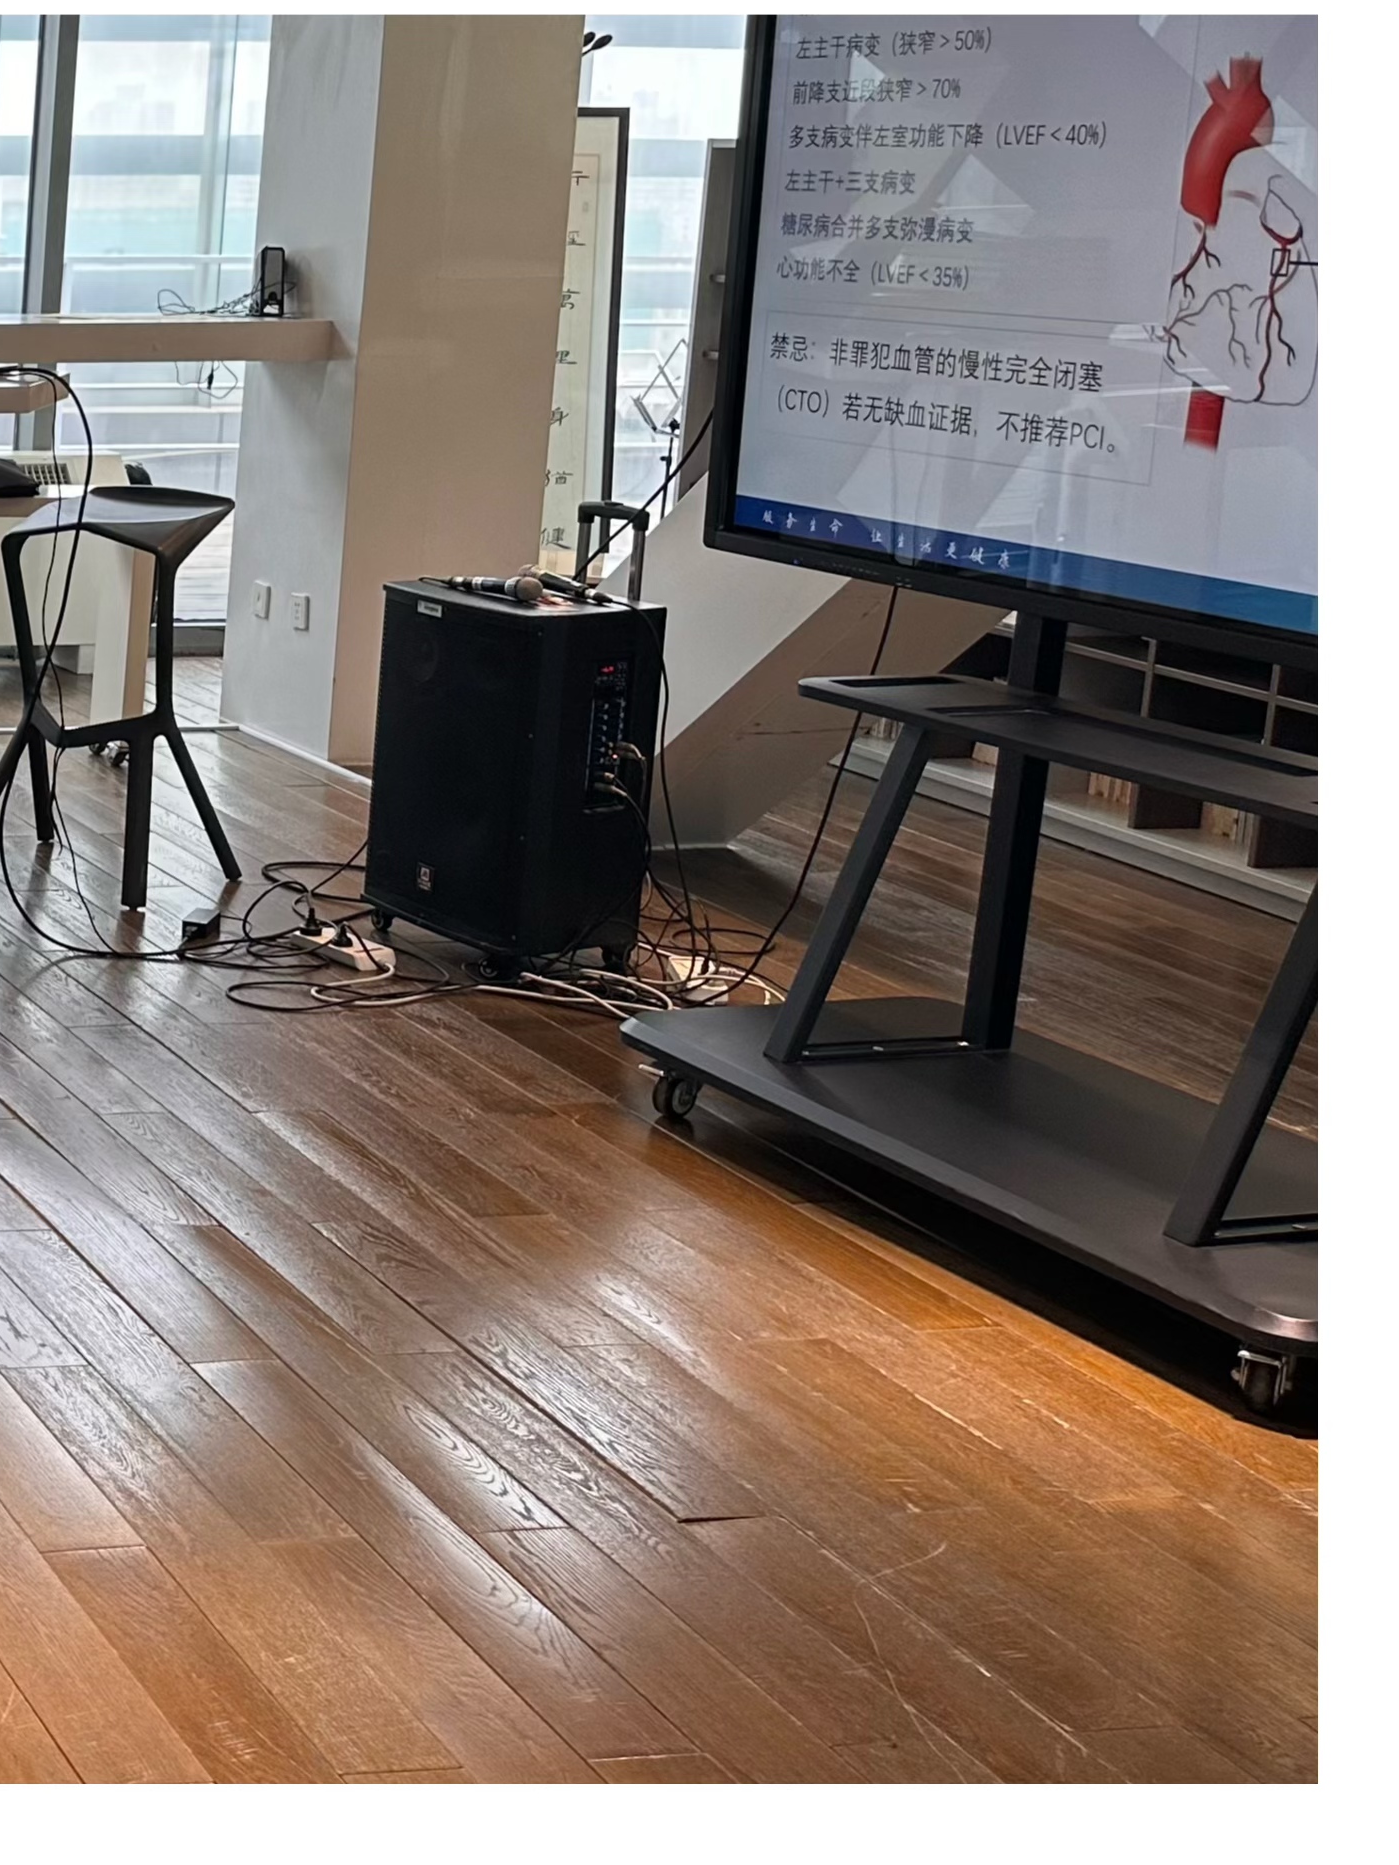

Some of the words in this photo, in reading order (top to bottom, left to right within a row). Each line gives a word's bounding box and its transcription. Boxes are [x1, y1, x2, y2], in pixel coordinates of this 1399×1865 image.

[783, 168, 917, 196] 左主干+三支病变
[779, 211, 976, 245] 糖尿病合并多支弥漫病变
